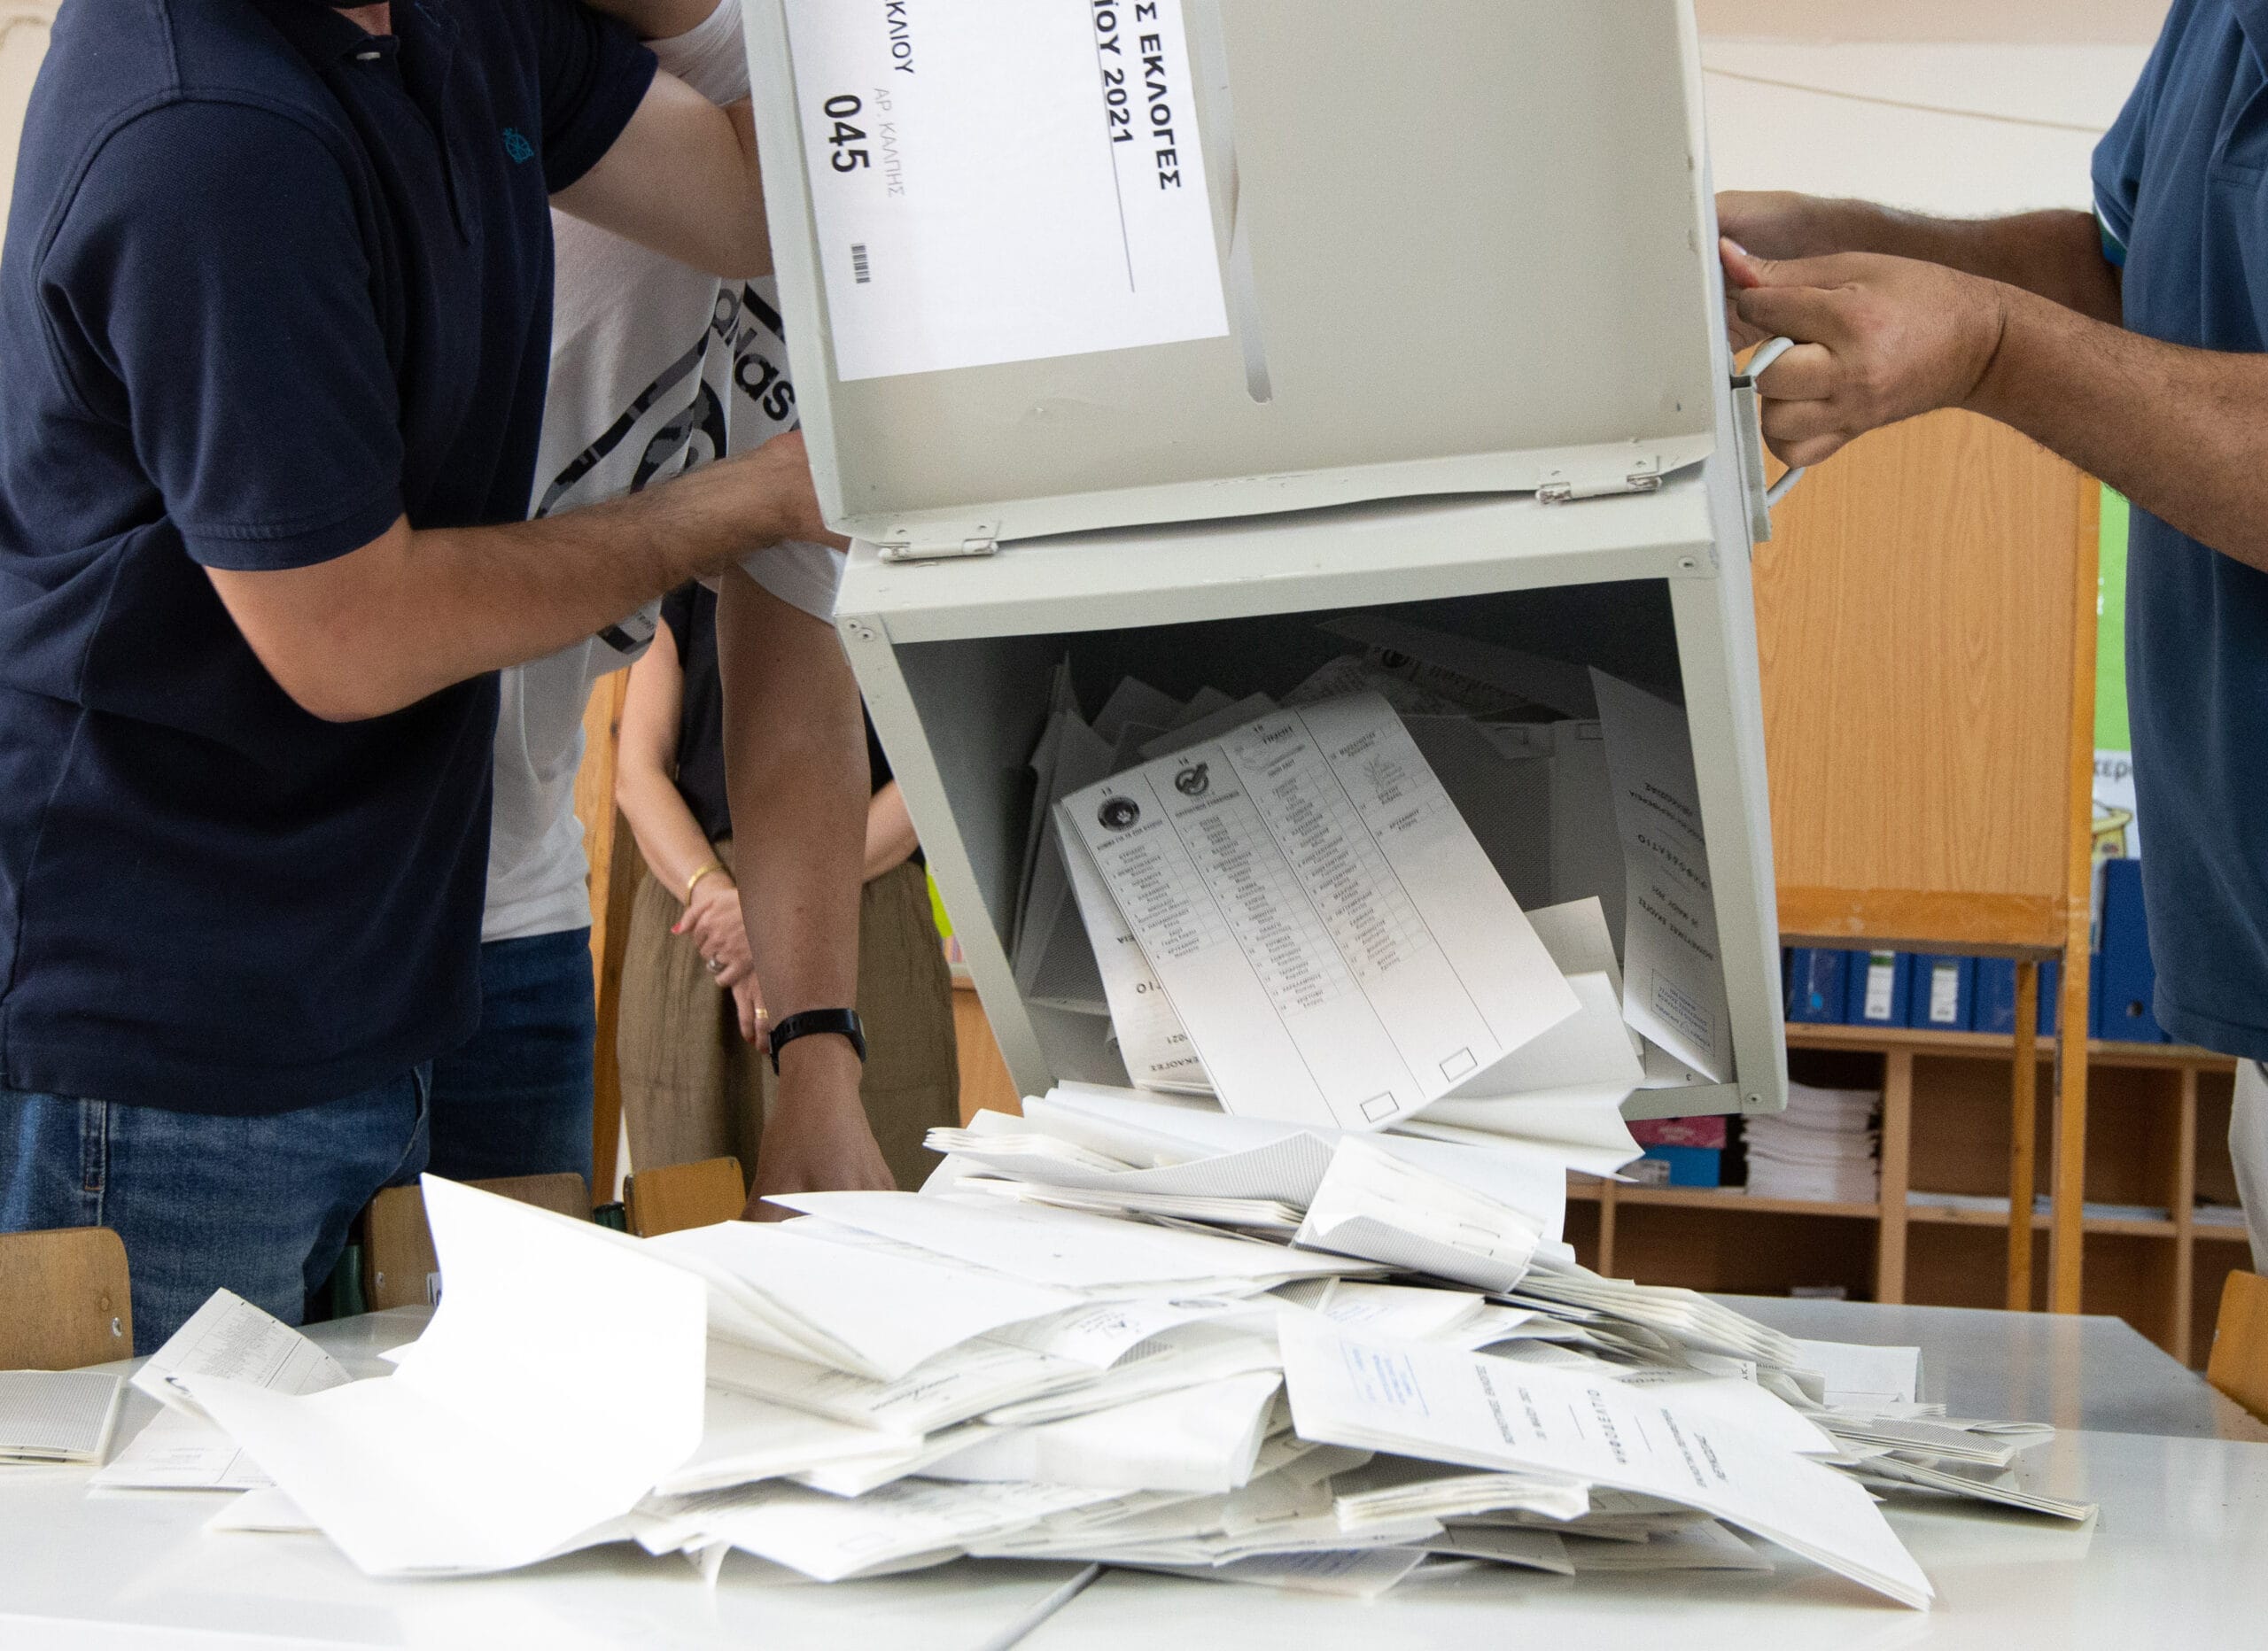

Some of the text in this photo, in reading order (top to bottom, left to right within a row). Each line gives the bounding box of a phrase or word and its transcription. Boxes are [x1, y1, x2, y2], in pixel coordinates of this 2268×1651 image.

[823, 94, 871, 173] 045
[1103, 67, 1134, 143] 2021
[1139, 34, 1181, 190] ΕΚΛΟΓΕΣ
[878, 121, 905, 198] ΚΑΛΠΗΣ
[1166, 1034, 1188, 1044] 021
